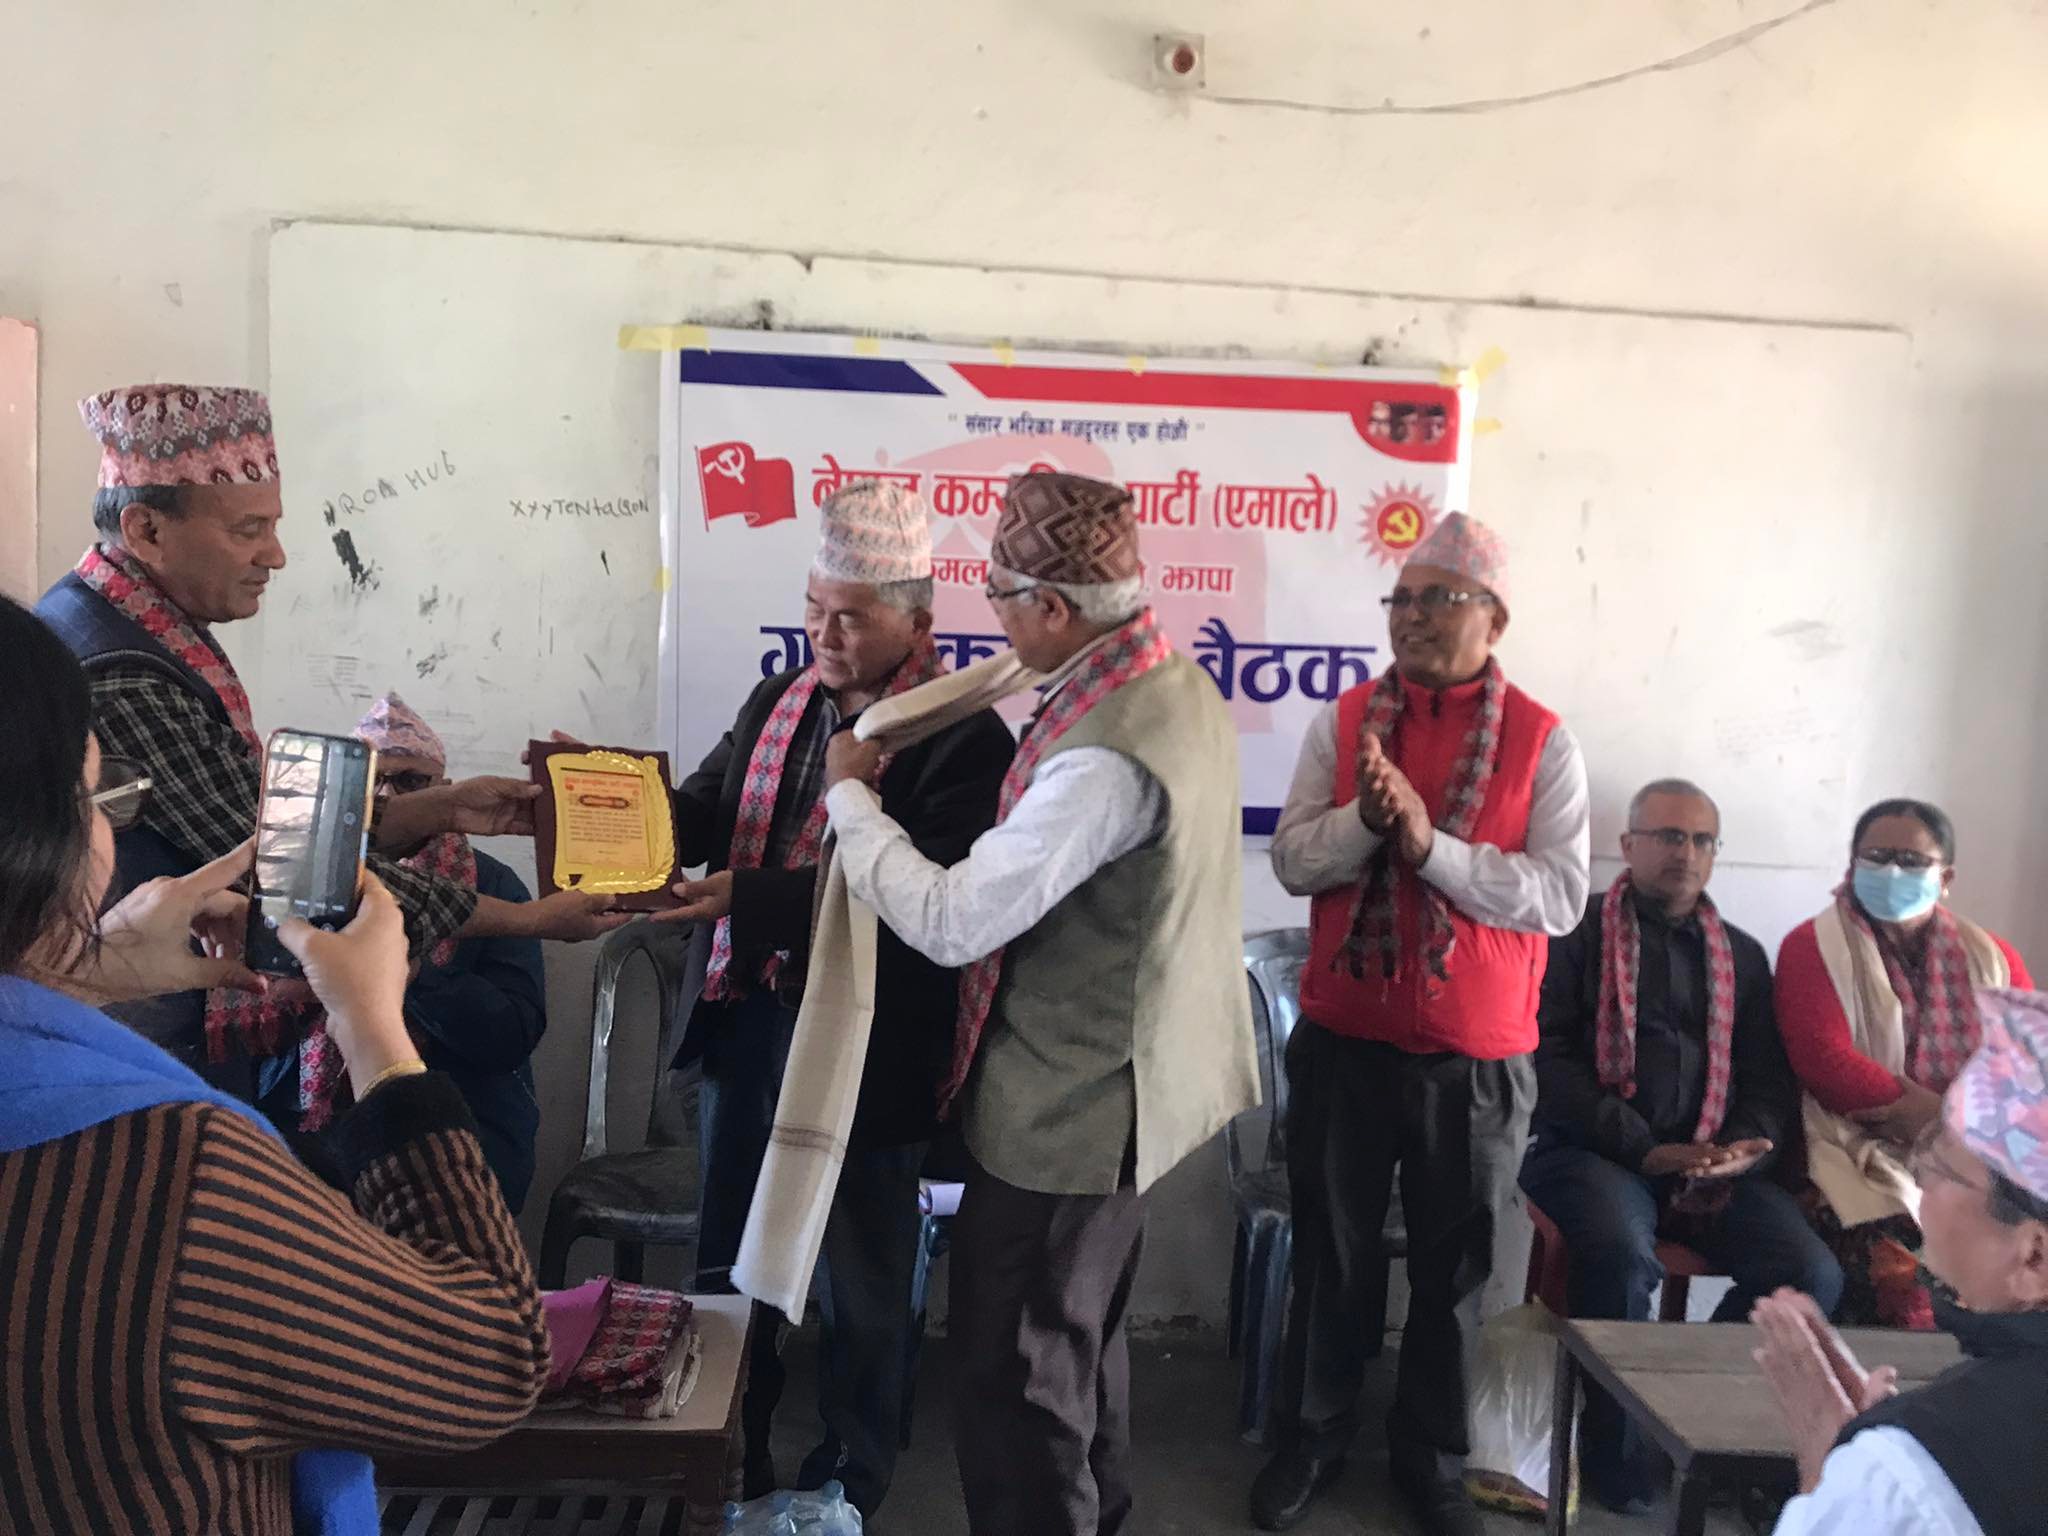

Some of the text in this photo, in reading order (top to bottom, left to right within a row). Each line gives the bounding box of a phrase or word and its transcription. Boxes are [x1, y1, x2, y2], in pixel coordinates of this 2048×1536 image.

[1127, 421, 1151, 444] एक
[1126, 468, 1200, 526] पार्टी
[1214, 472, 1338, 532] (एमाले)
[1162, 564, 1234, 592] झापा
[1193, 616, 1376, 703] बैठक
